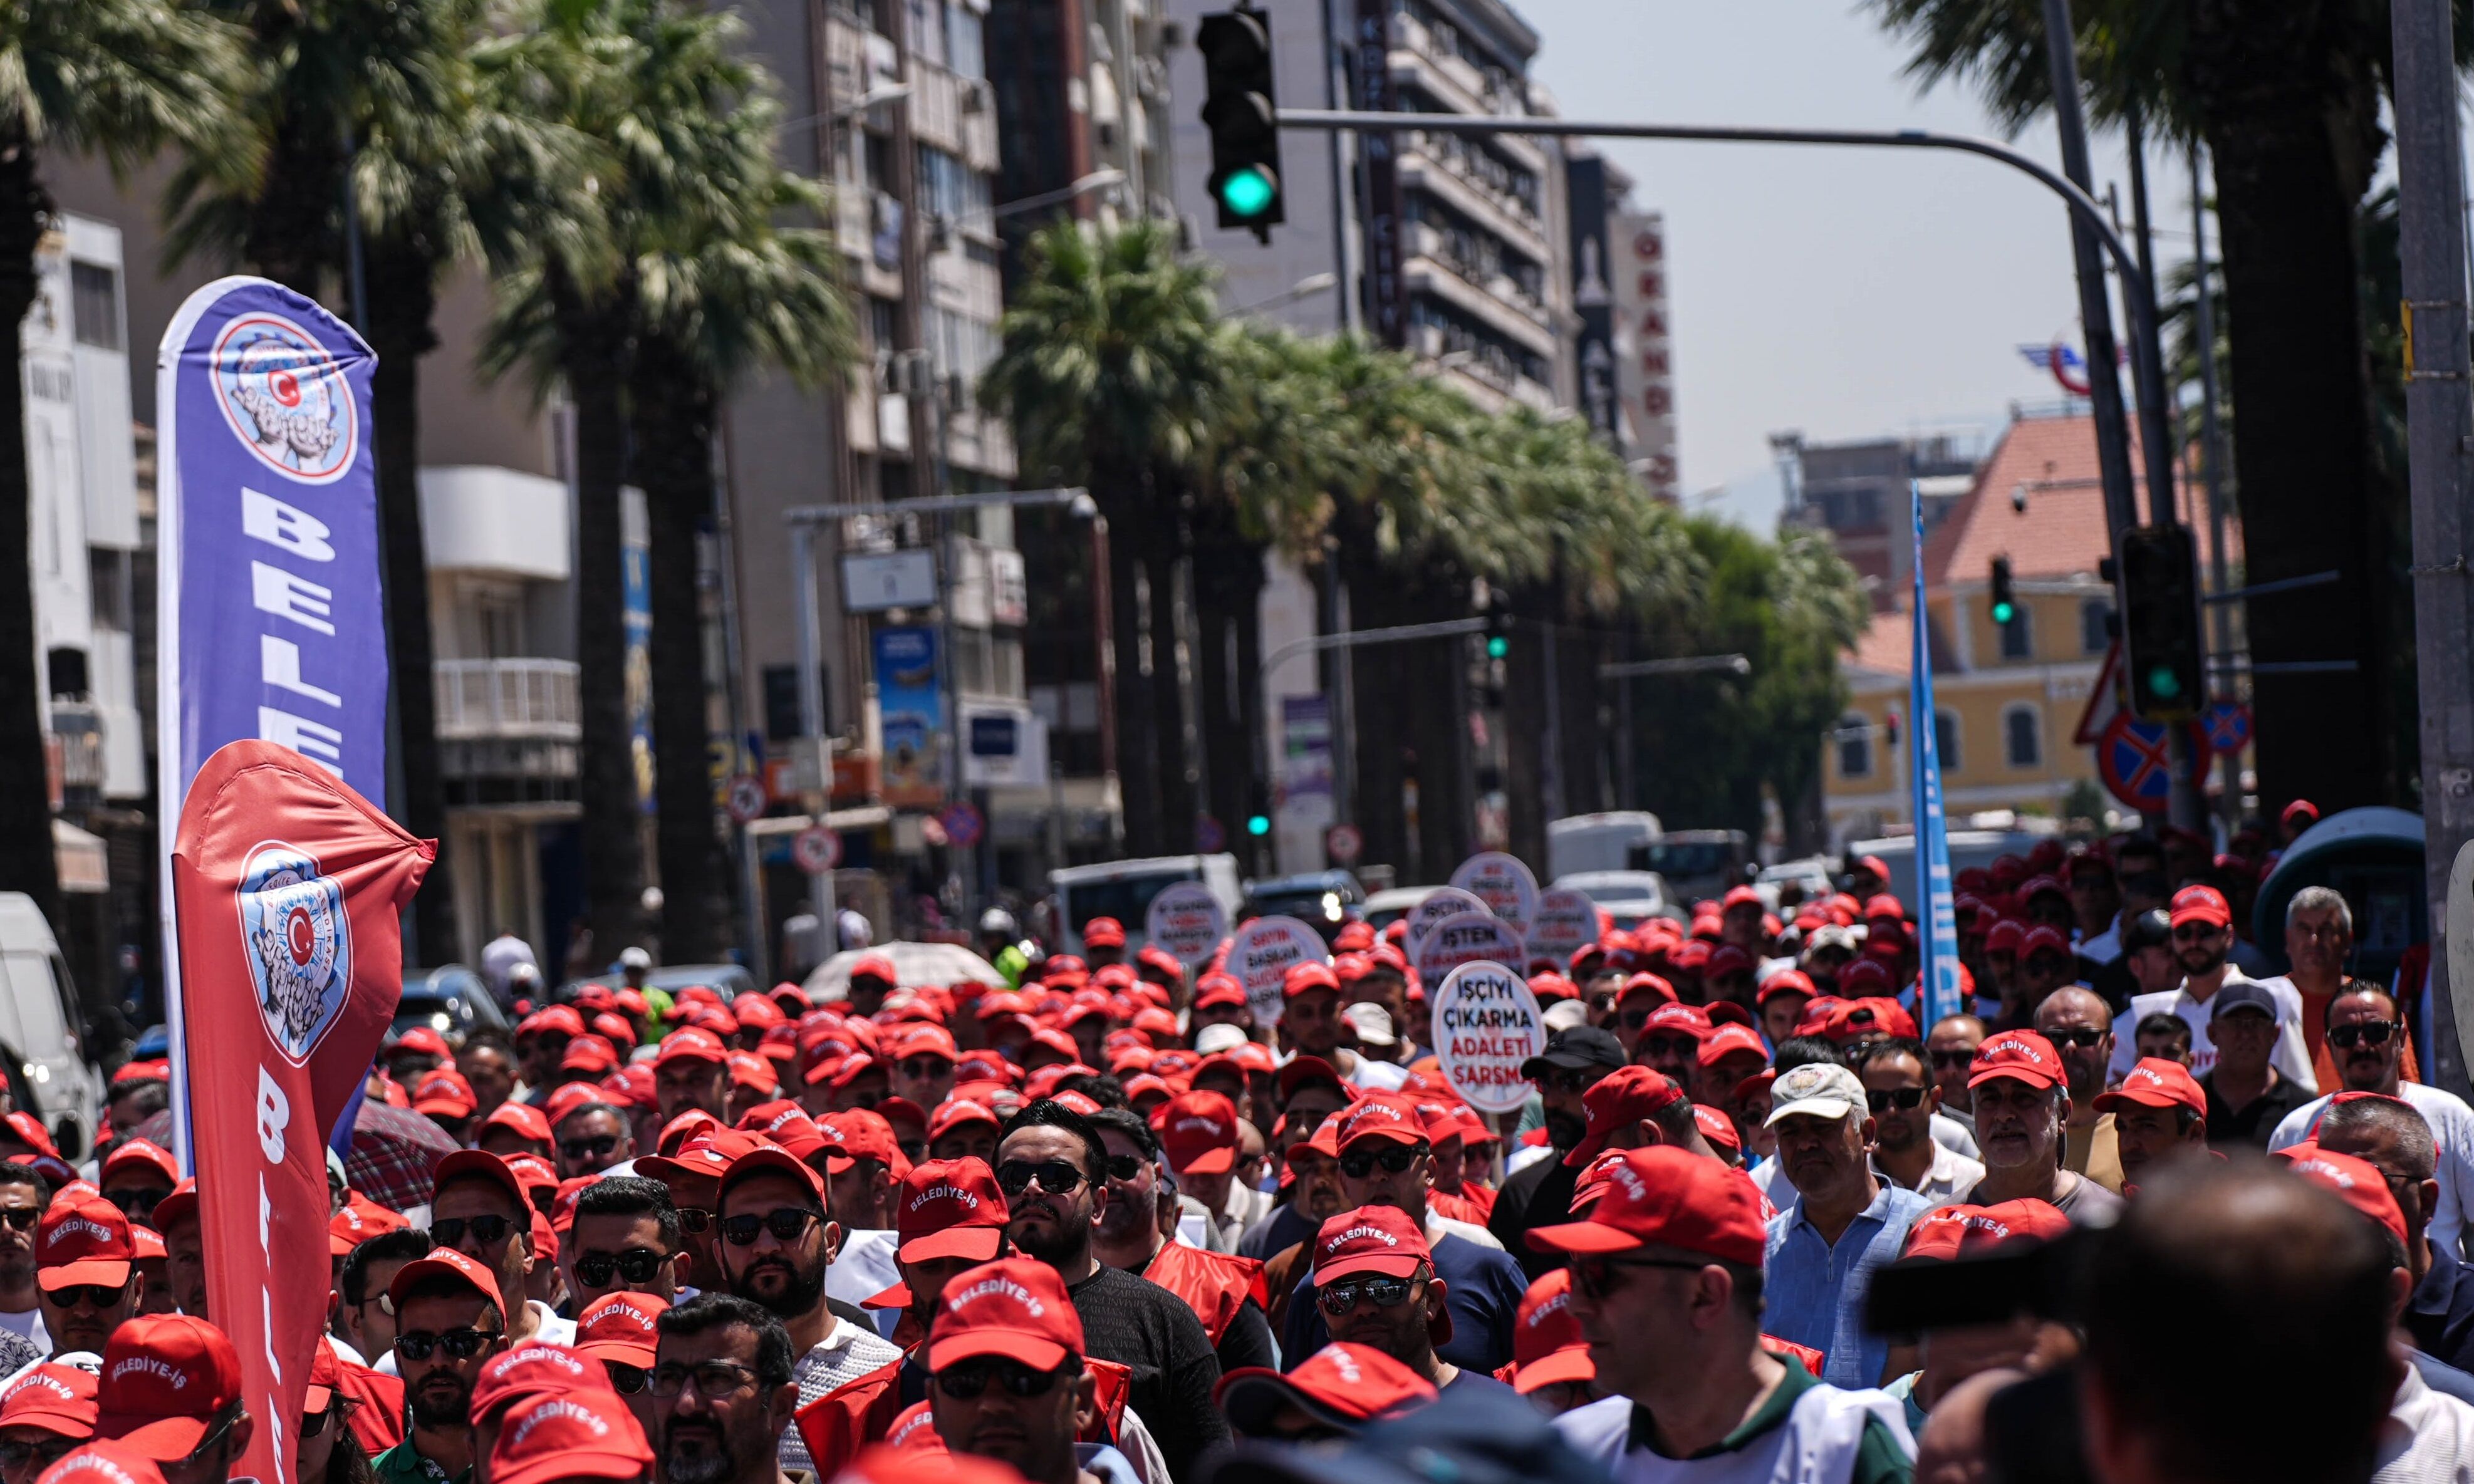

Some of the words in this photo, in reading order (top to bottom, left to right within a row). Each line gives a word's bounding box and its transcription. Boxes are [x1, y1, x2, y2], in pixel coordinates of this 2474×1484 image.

[1458, 975, 1513, 1002] İŞÇİYİ
[1444, 1008, 1532, 1030] ÇIKARMA
[1451, 1032, 1532, 1056] ADALETİ
[910, 1184, 979, 1213] BELEDİYE-İŞ
[49, 1218, 112, 1244] BELEDİYE-İŞ
[1327, 1225, 1398, 1254] BELEDİYE-İŞ
[949, 1276, 1046, 1318] BELEDİYE-İŞ
[585, 1302, 654, 1331] BELEDİYE-İŞ
[112, 1355, 187, 1389] BELEDİYE-İŞ
[494, 1347, 584, 1378] BELEDİYE-İŞ
[5, 1372, 74, 1401] BELEDİYE-İŞ
